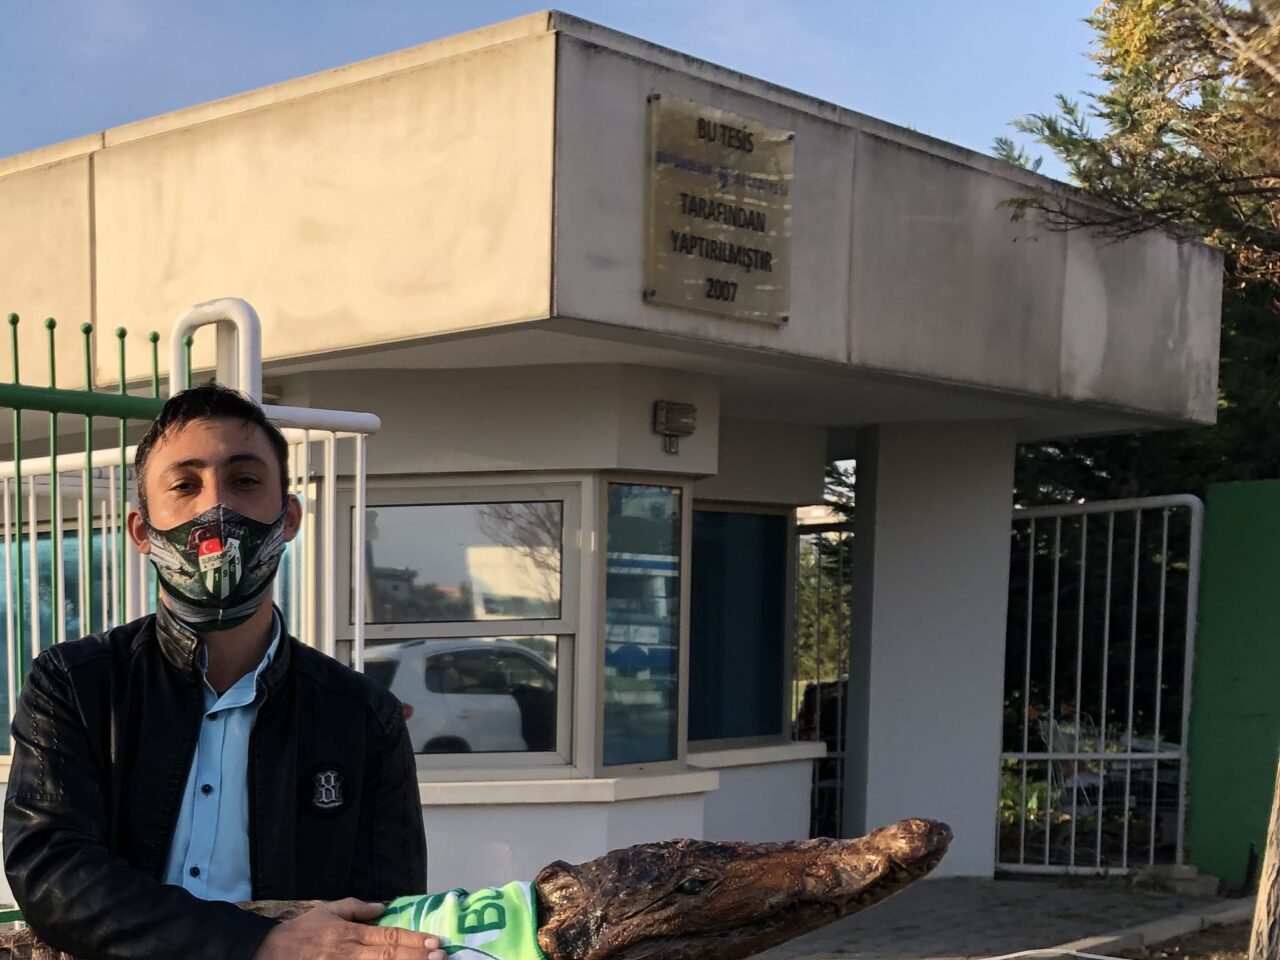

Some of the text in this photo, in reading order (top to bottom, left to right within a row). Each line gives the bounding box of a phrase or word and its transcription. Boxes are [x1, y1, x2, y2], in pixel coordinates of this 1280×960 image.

[697, 117, 717, 142] BU
[680, 192, 766, 233] TARAFINDAN
[706, 277, 738, 302] 2007
